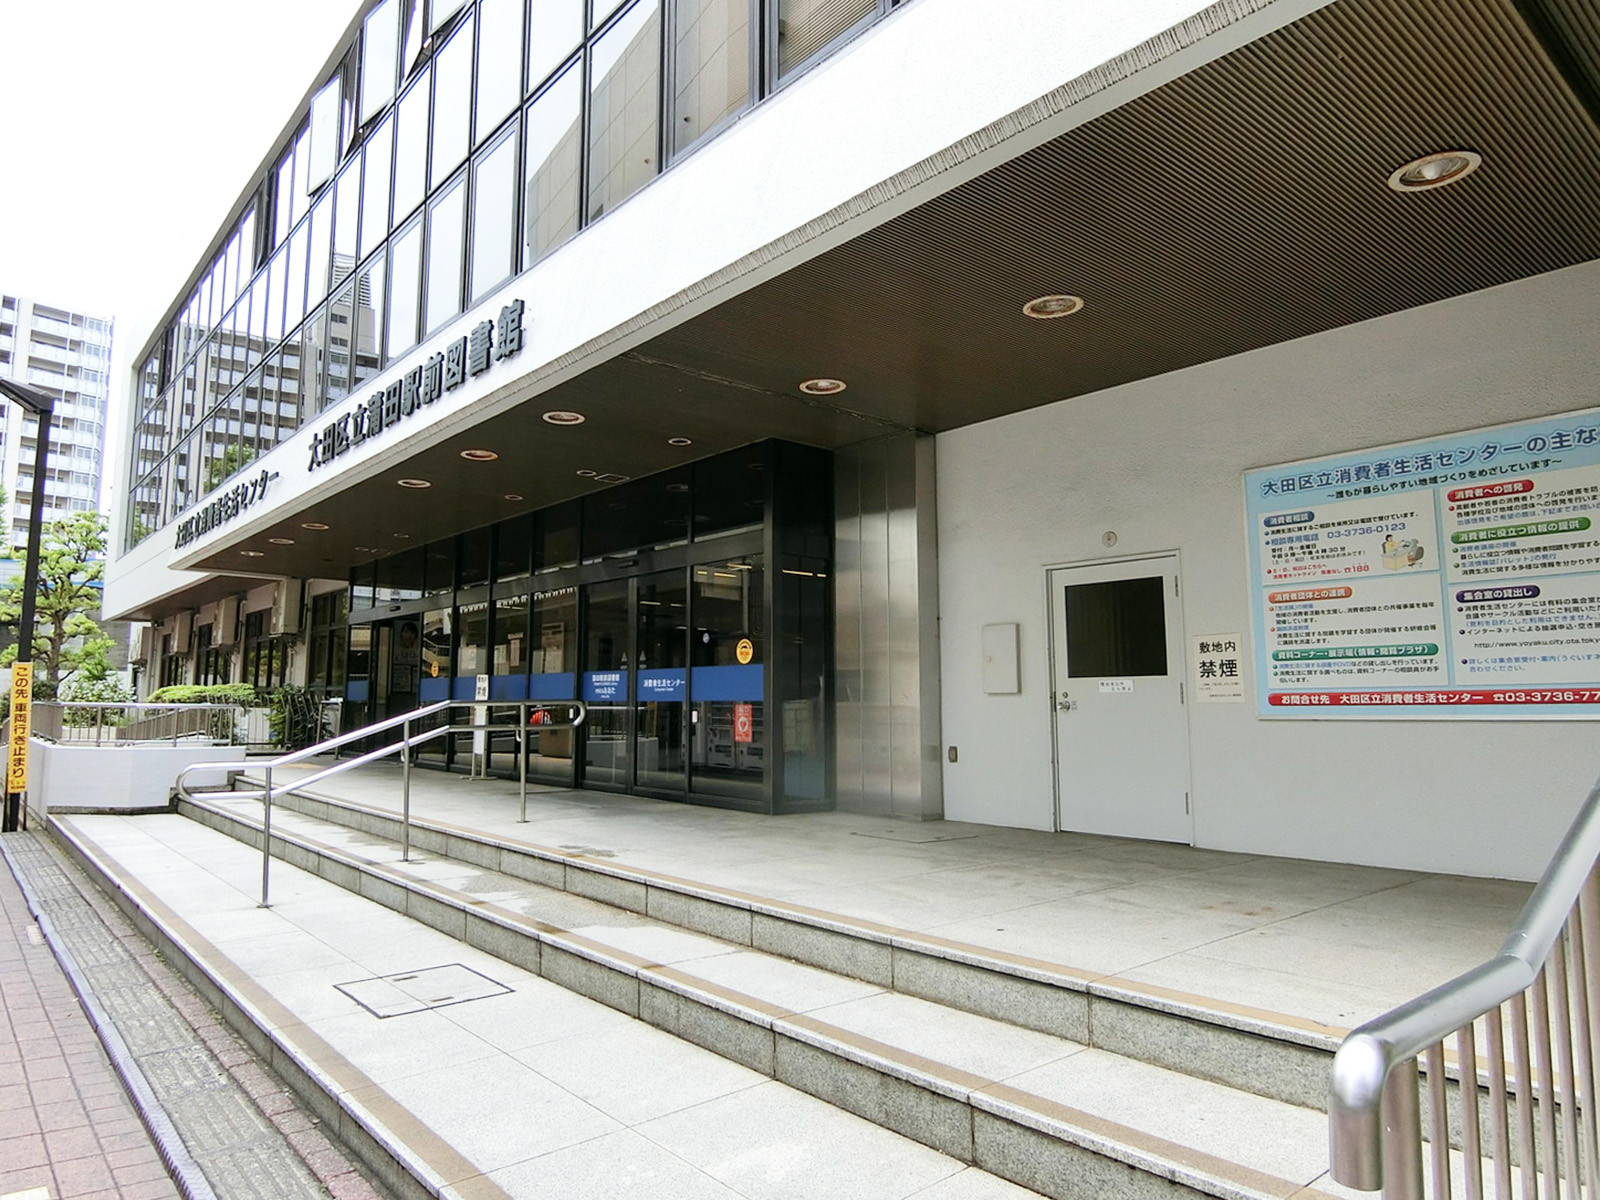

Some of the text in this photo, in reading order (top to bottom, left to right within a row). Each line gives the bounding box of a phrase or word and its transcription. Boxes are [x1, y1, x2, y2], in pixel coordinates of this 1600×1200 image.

[308, 298, 525, 472] 大田区立蒲田駅前図書館
[1263, 429, 1597, 495] 大田区立消費者生活センターの主な
[1327, 522, 1406, 539] 03-3736-0123
[1199, 640, 1236, 654] 敷地内
[1199, 659, 1239, 678] 禁煙
[15, 666, 28, 699] この先
[1281, 694, 1330, 704] お問合せ先
[1339, 692, 1484, 704] 大田区立消費者生活センター
[13, 702, 27, 778] 車両行き止まり
